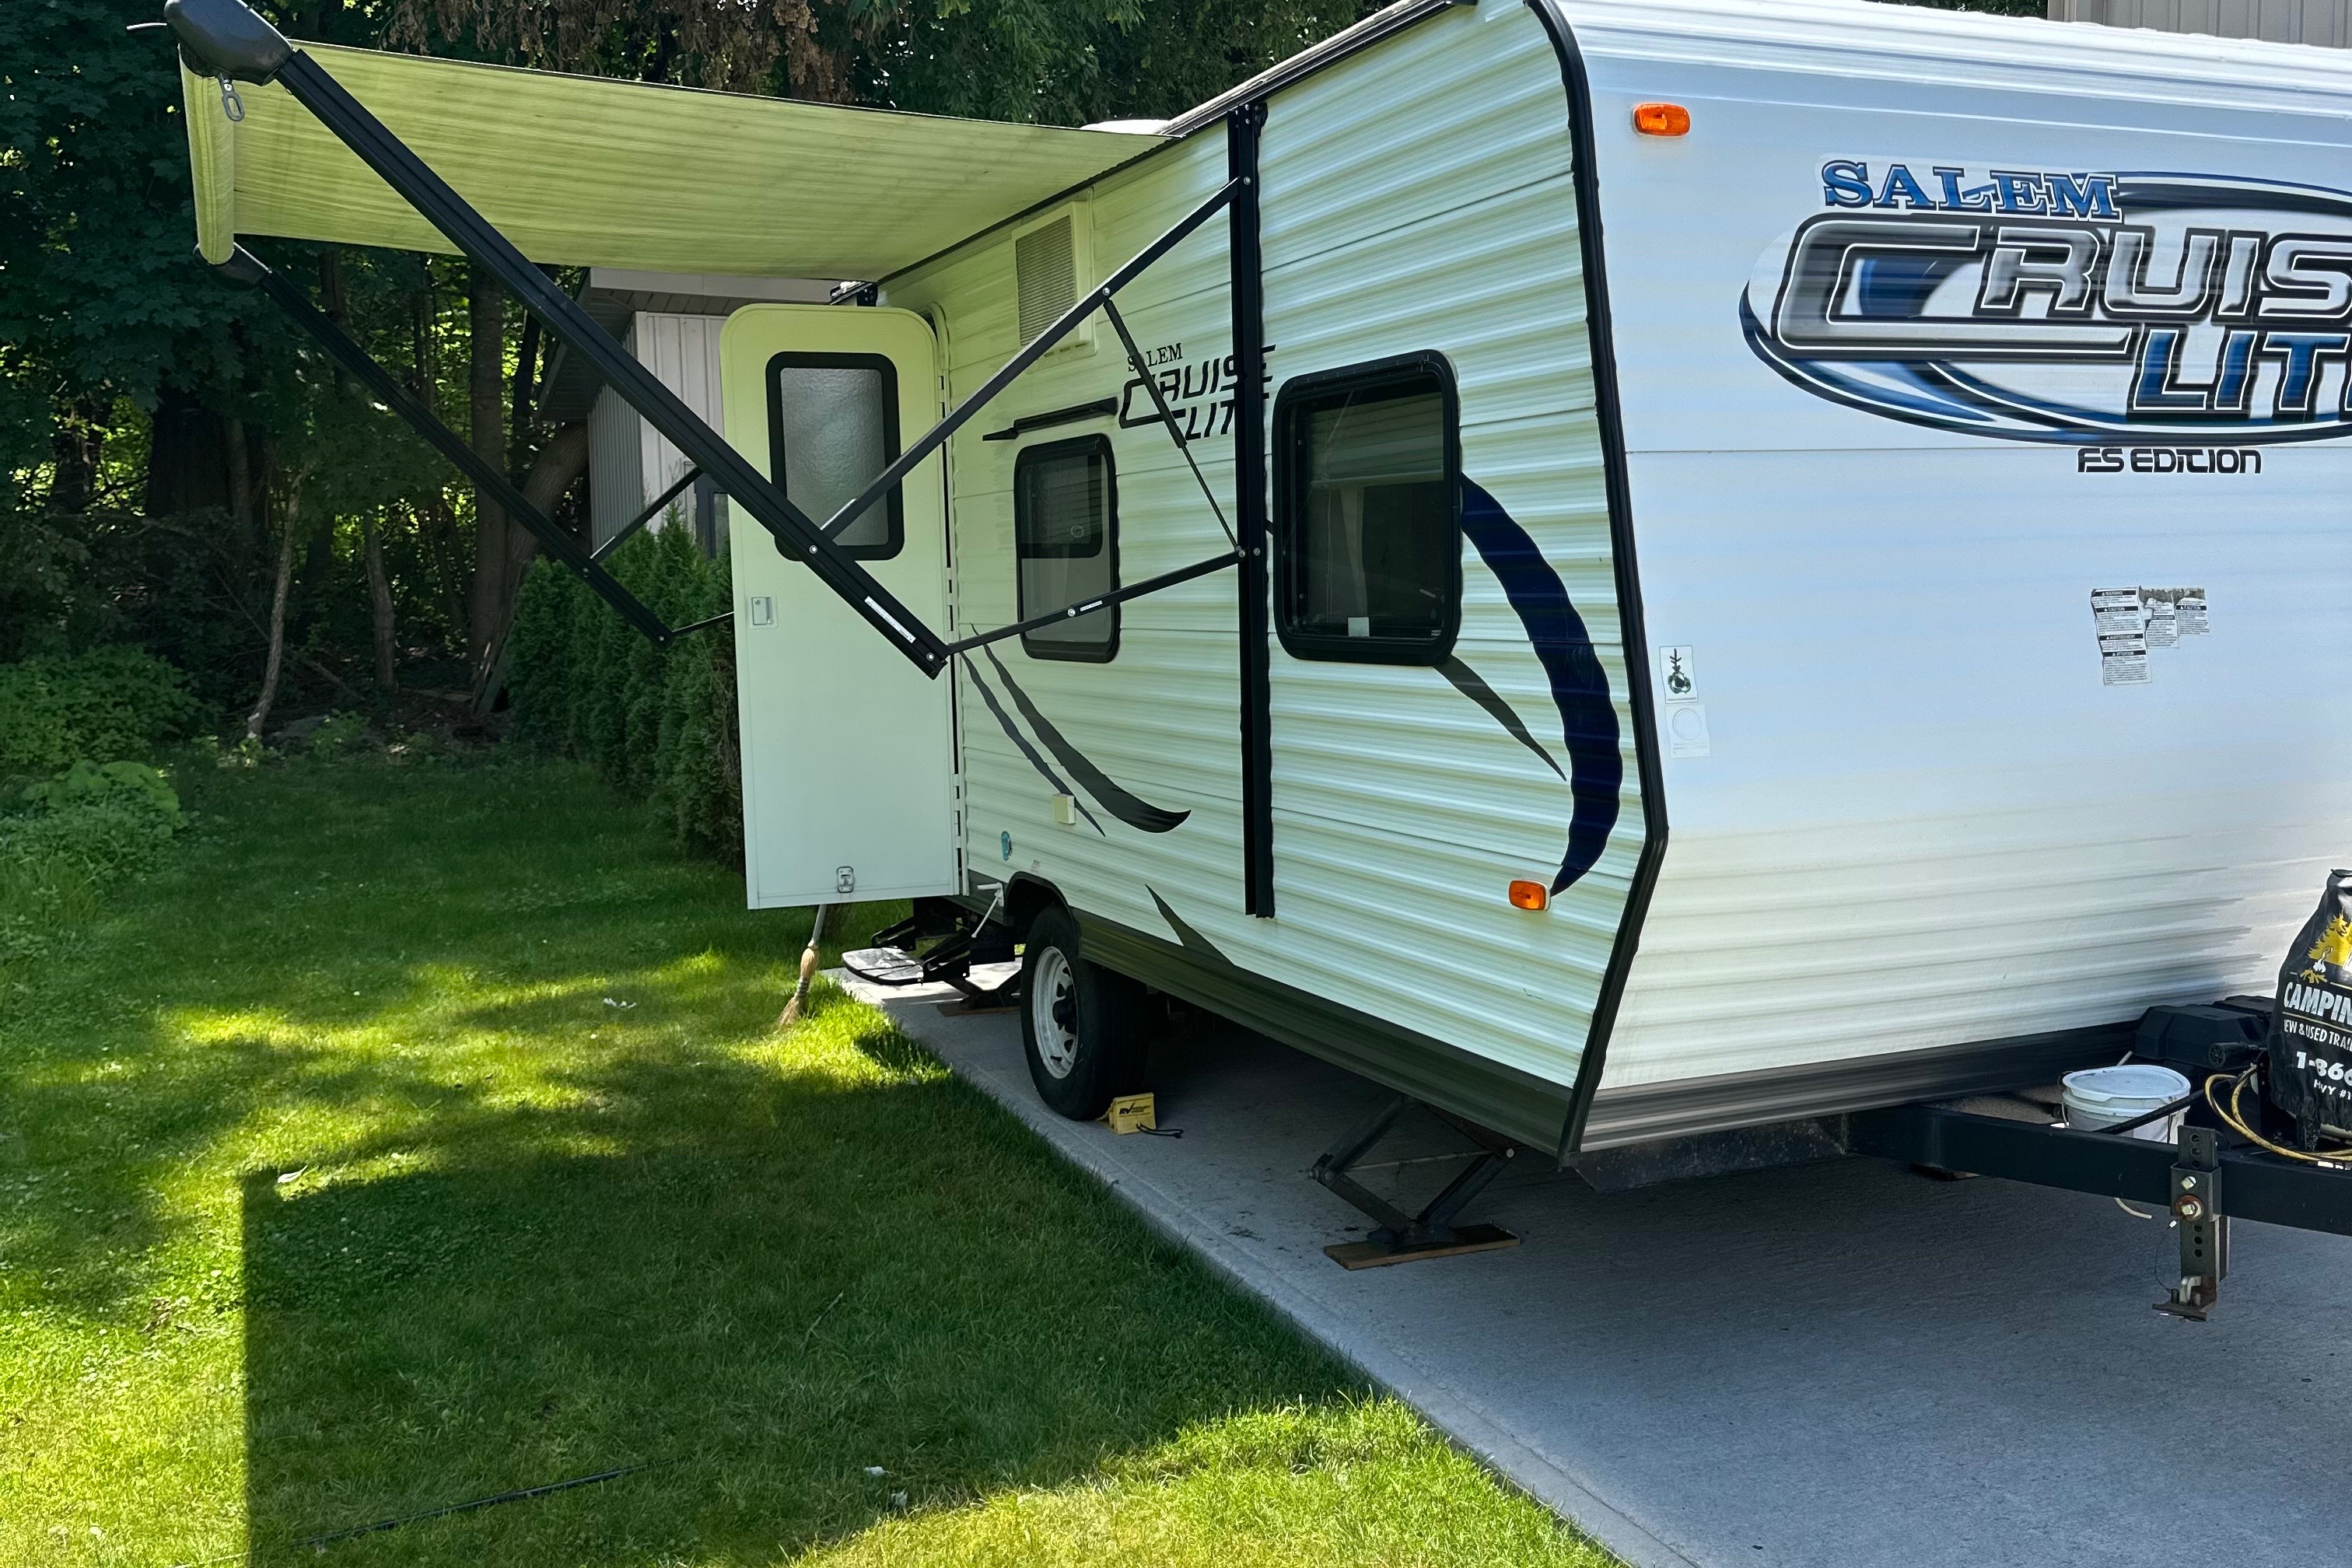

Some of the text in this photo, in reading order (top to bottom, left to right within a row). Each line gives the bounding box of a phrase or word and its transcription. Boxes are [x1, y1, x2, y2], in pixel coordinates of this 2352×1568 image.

[1822, 159, 2121, 219] SALEM
[1127, 343, 1183, 372] SLEM
[2126, 324, 2352, 421] LIT
[2077, 448, 2262, 474] FS EDITION
[2284, 982, 2352, 1026] CAMPIN
[2284, 1019, 2298, 1034] EW
[2305, 1024, 2328, 1042] USED
[2313, 1079, 2352, 1101] HVY #1
